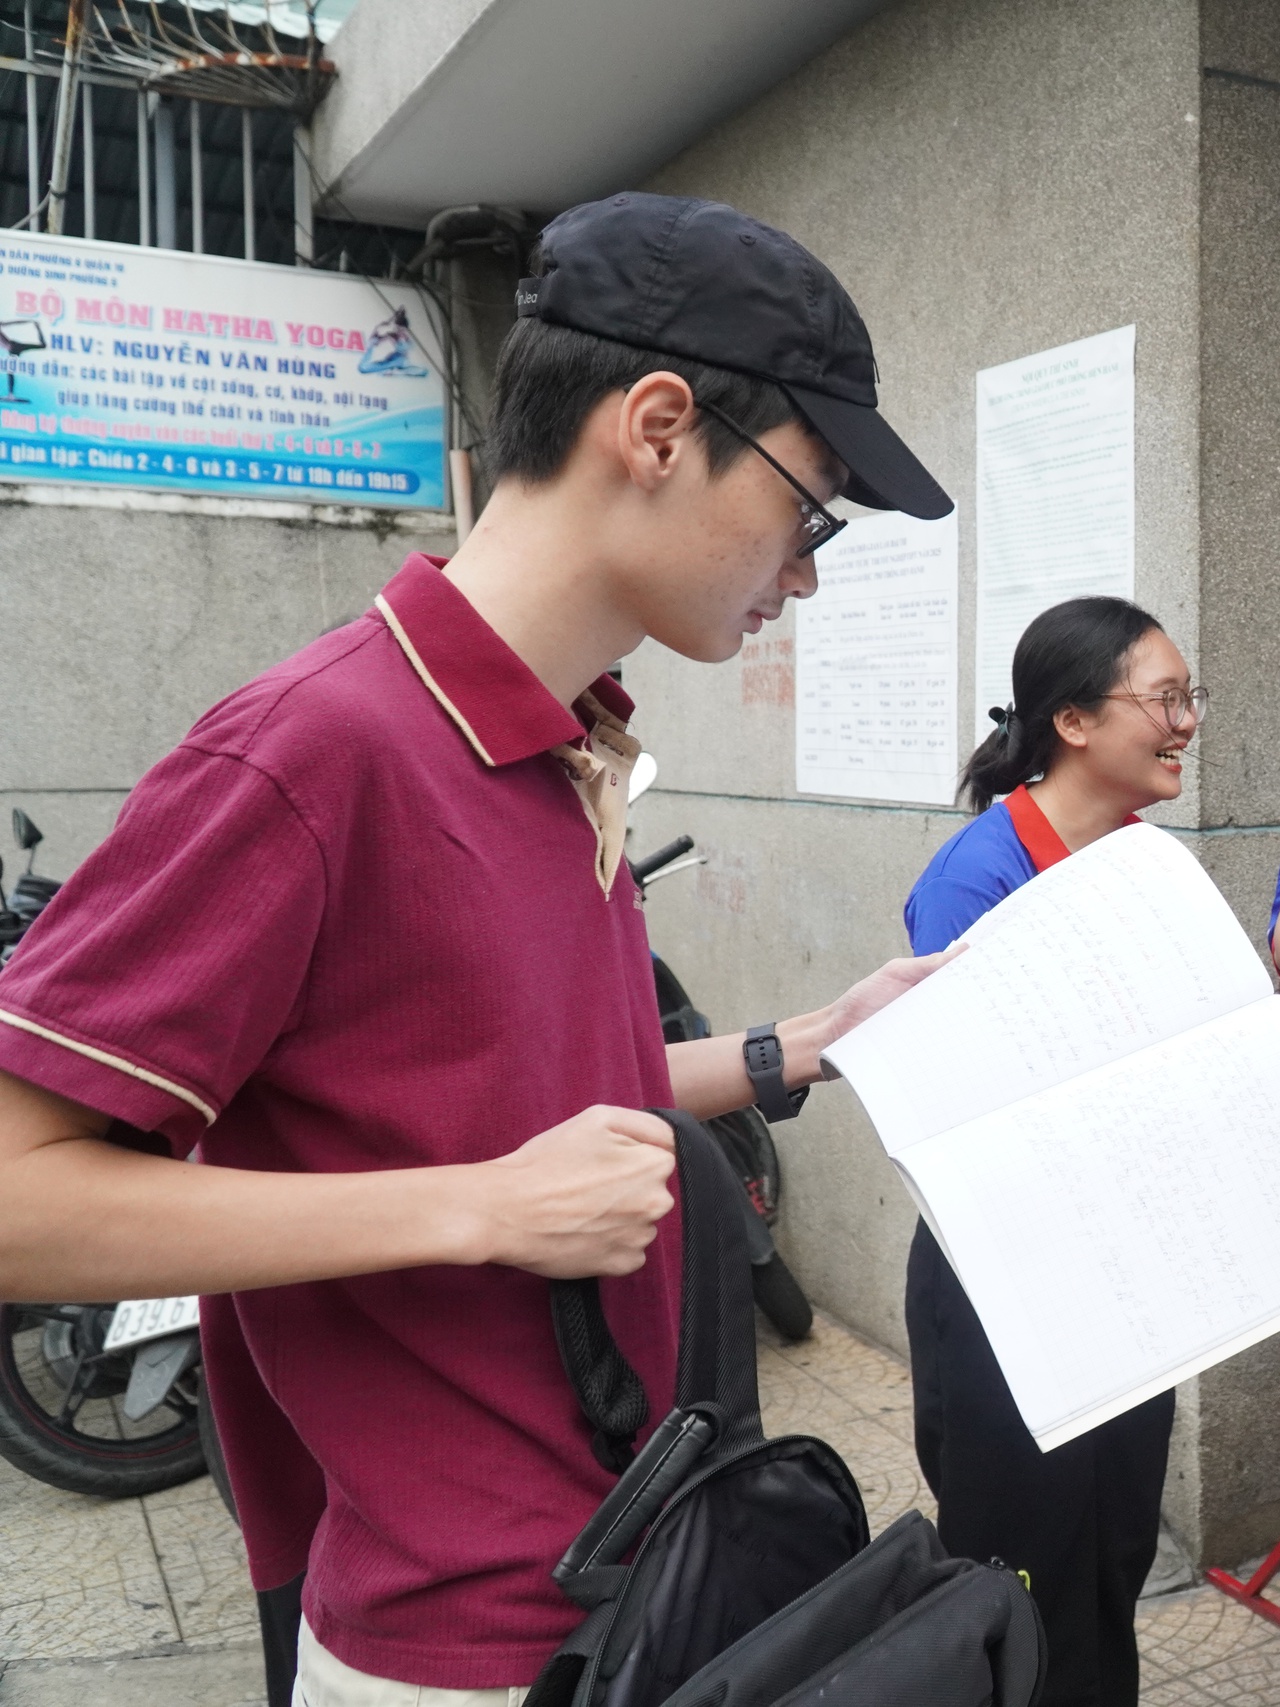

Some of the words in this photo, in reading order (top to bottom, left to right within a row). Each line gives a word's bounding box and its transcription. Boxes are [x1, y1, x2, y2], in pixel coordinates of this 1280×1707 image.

[524, 291, 538, 304] Jea
[16, 287, 62, 324] BỘ
[76, 295, 150, 328] MÔN
[163, 307, 276, 342] HATHA
[286, 324, 366, 353] YOGA
[0, 358, 36, 376] ướng
[51, 334, 104, 356] HLV:
[114, 340, 210, 366] NGUYỄN
[221, 350, 268, 372] VĂN
[278, 357, 336, 379] HÙNG
